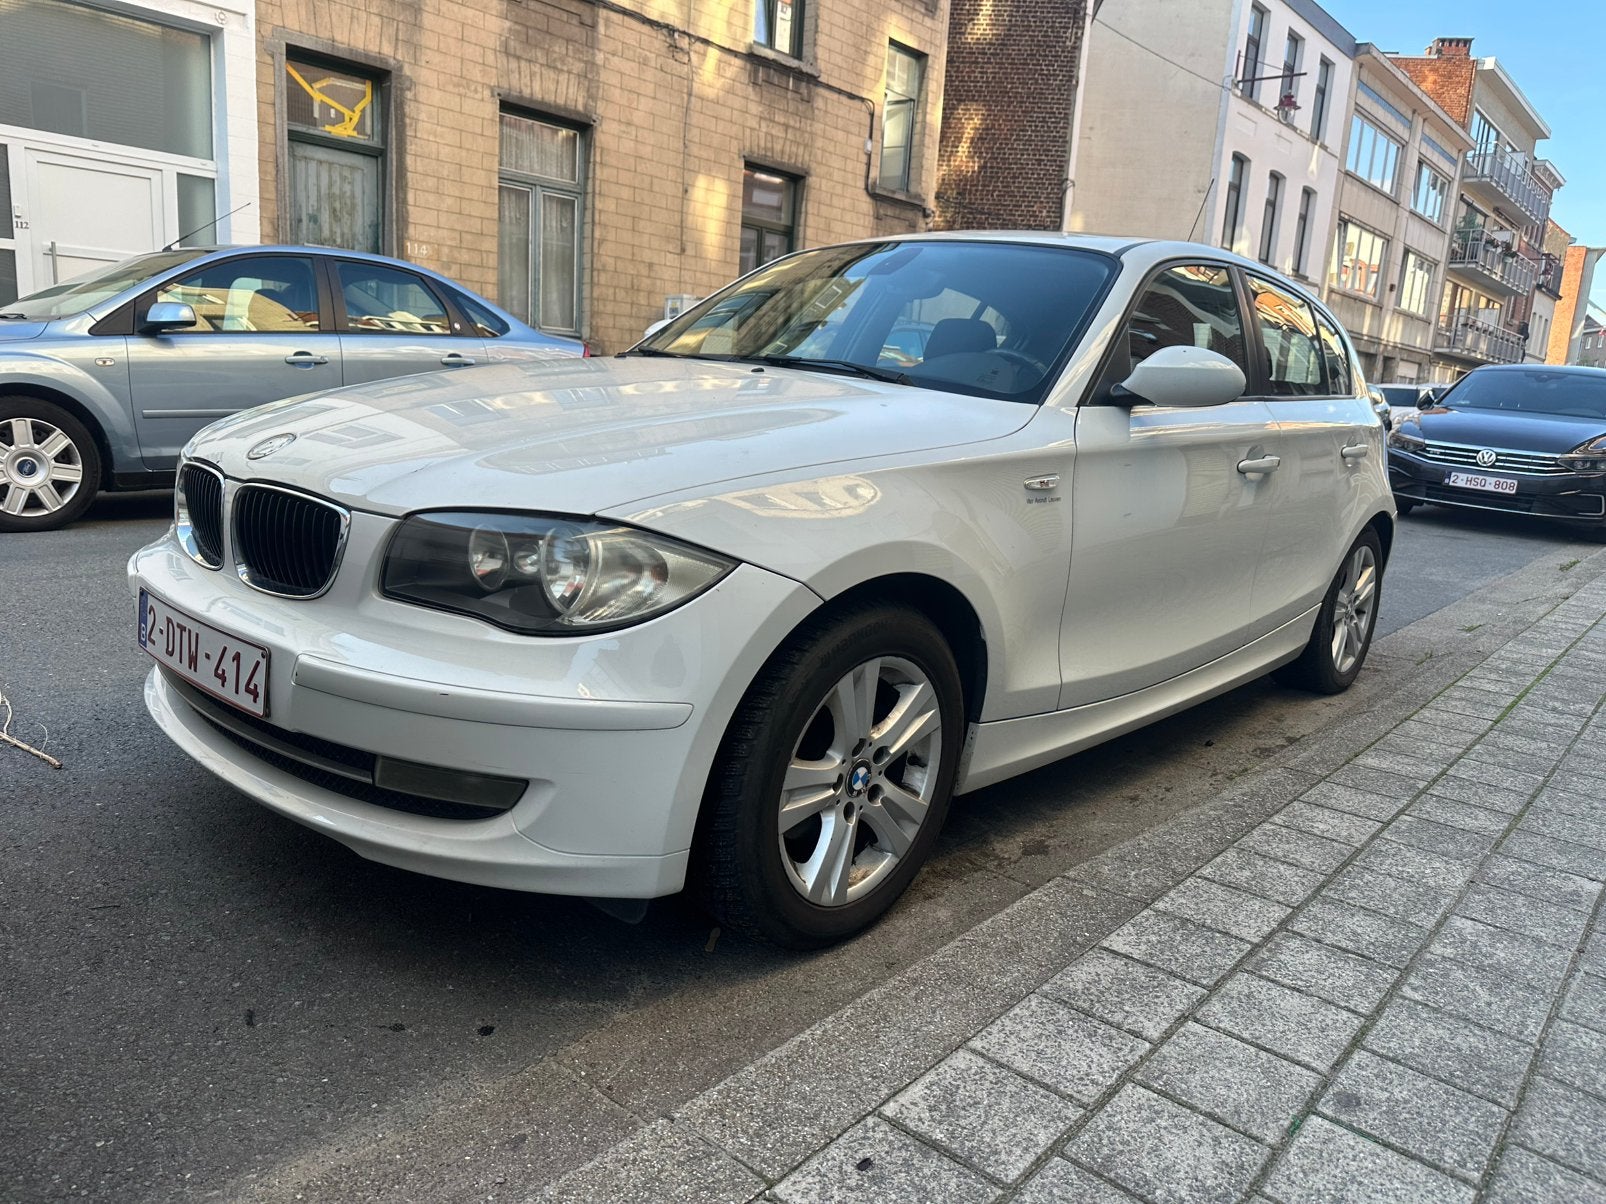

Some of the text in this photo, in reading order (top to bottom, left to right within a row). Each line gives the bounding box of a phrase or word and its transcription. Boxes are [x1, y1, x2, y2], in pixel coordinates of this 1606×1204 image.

[15, 221, 29, 229] 112
[406, 241, 428, 256] 114
[140, 623, 147, 641] B
[147, 605, 261, 704] 2-DTW-414
